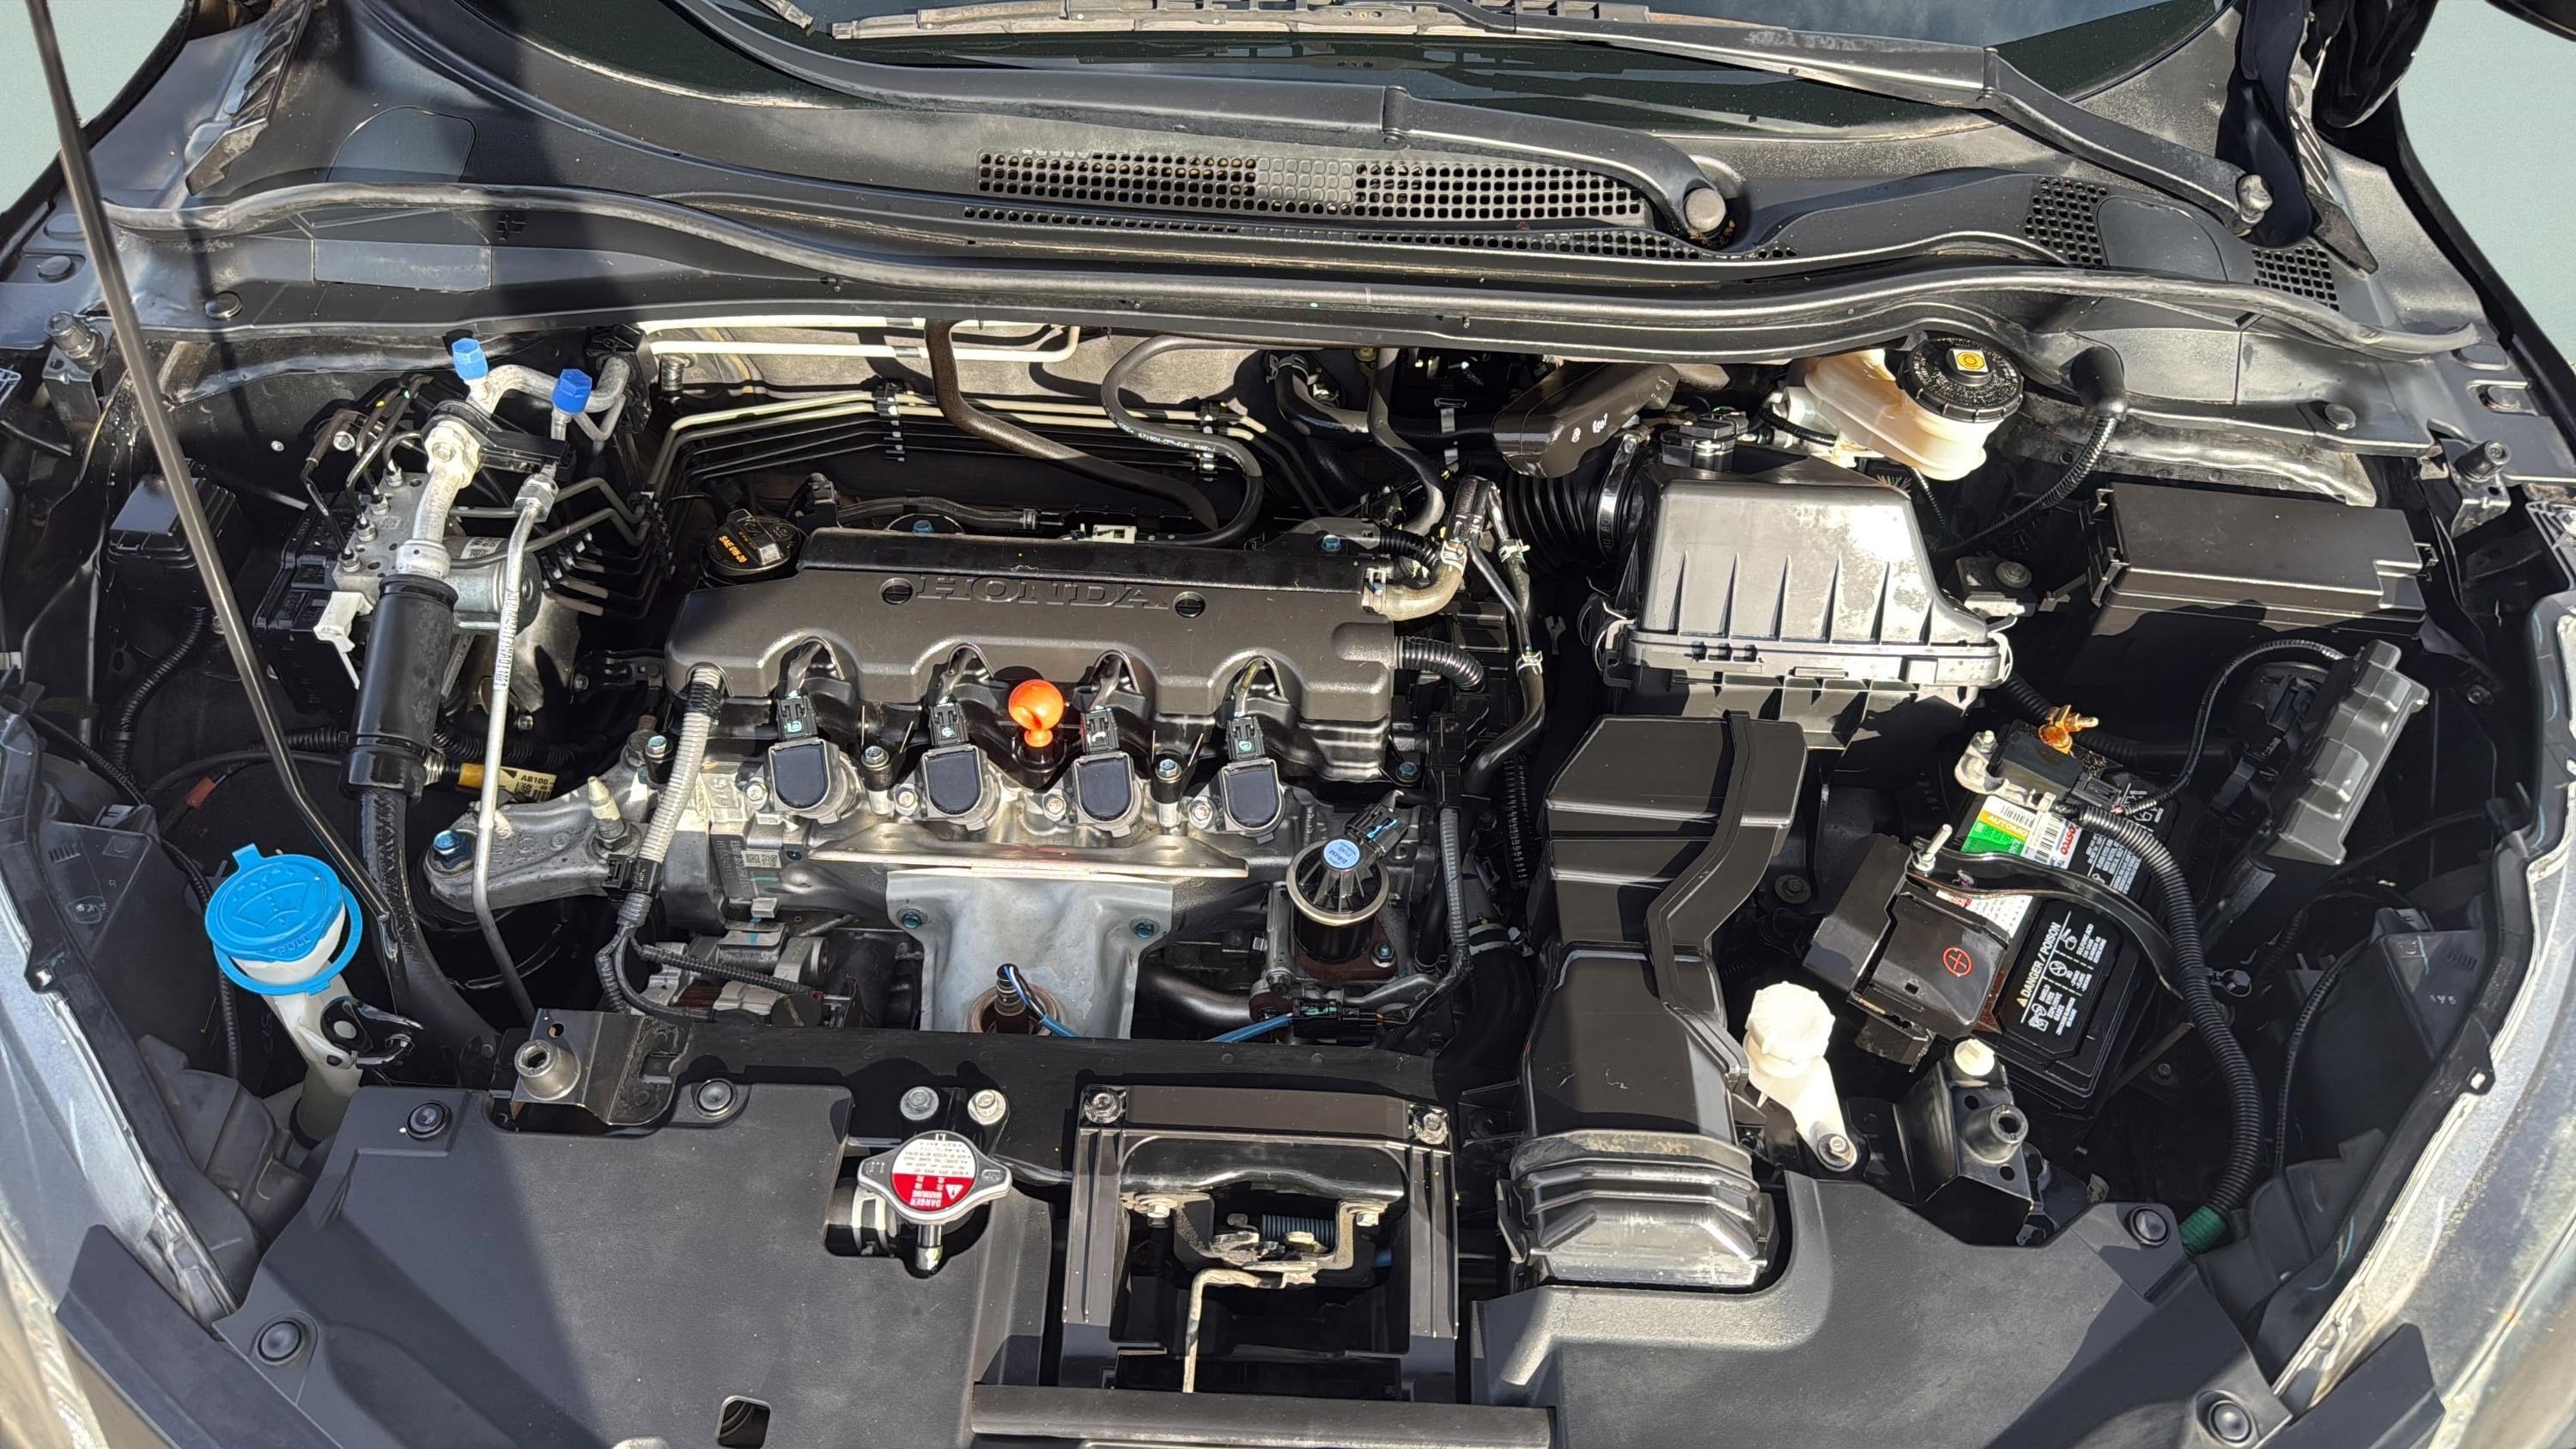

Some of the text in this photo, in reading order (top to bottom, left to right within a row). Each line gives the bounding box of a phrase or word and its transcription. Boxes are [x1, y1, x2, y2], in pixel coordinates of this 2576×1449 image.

[719, 535, 732, 550] SAE
[916, 575, 1170, 611] HONDA
[2060, 825, 2079, 855] OSTCO
[2020, 960, 2044, 999] DANGER
[2039, 922, 2061, 955] POISON
[909, 1197, 941, 1207] DANGER
